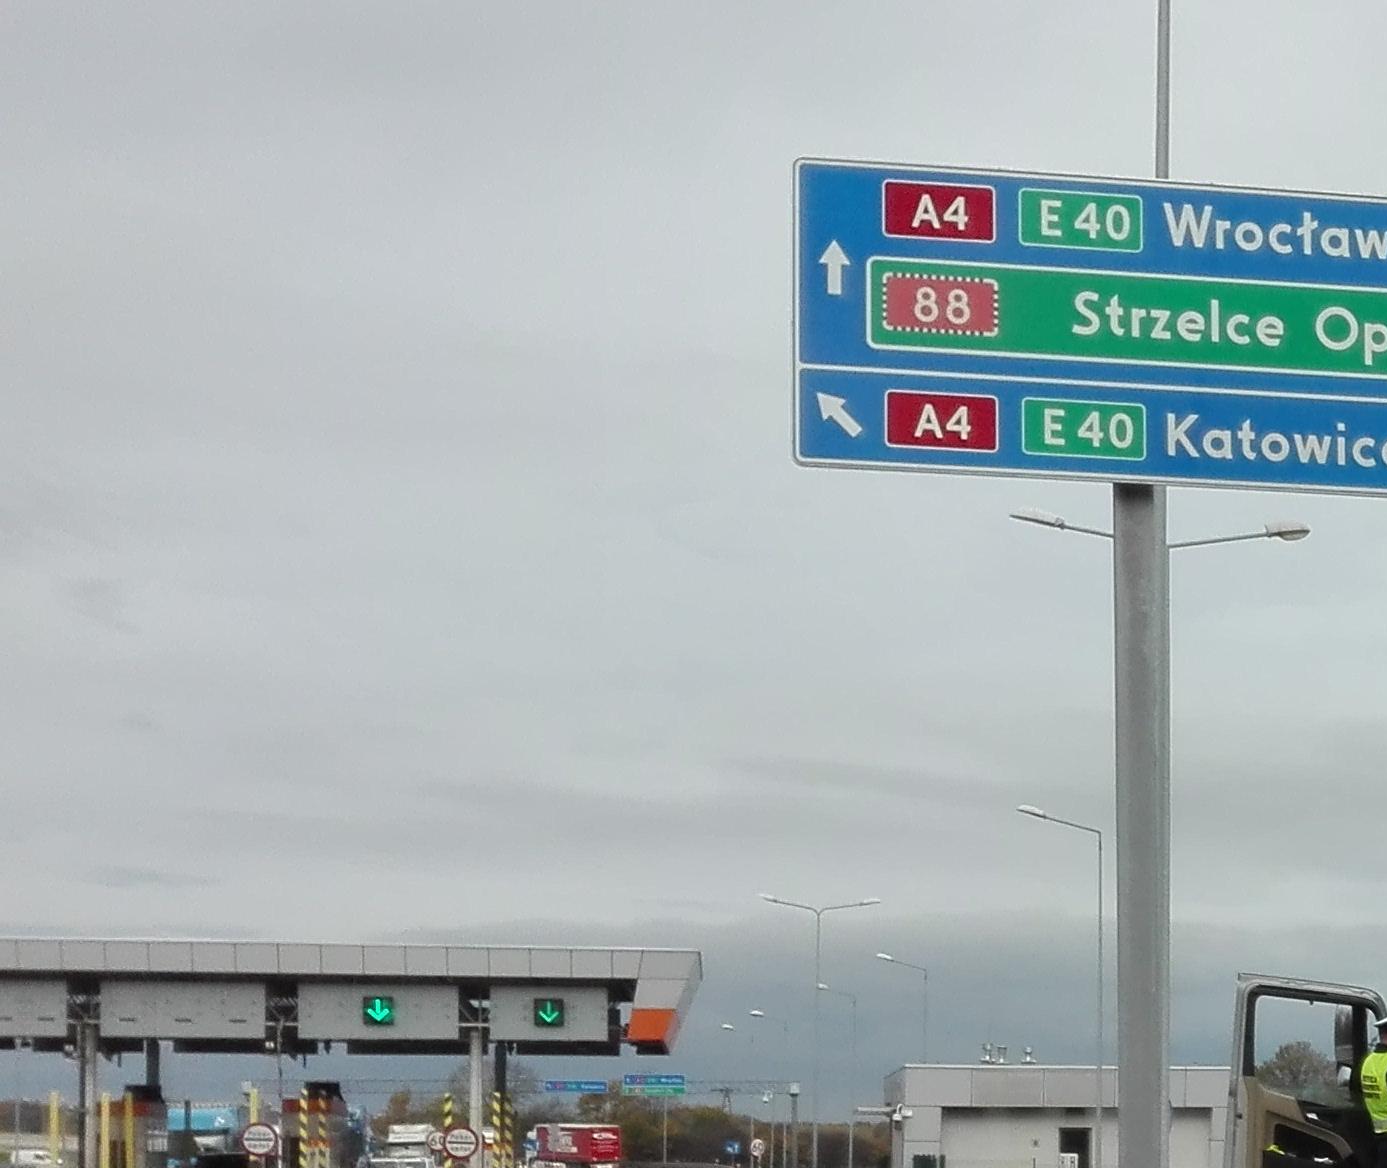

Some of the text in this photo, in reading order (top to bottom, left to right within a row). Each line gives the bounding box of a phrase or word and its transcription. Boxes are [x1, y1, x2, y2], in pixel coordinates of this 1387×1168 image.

[911, 193, 969, 231] A4
[1040, 199, 1063, 237] E
[1074, 202, 1131, 241] 40
[914, 286, 971, 325] 88
[1071, 290, 1284, 346] Strzelce
[914, 403, 972, 441] A4
[1043, 408, 1066, 446] E
[1077, 411, 1134, 449] 40
